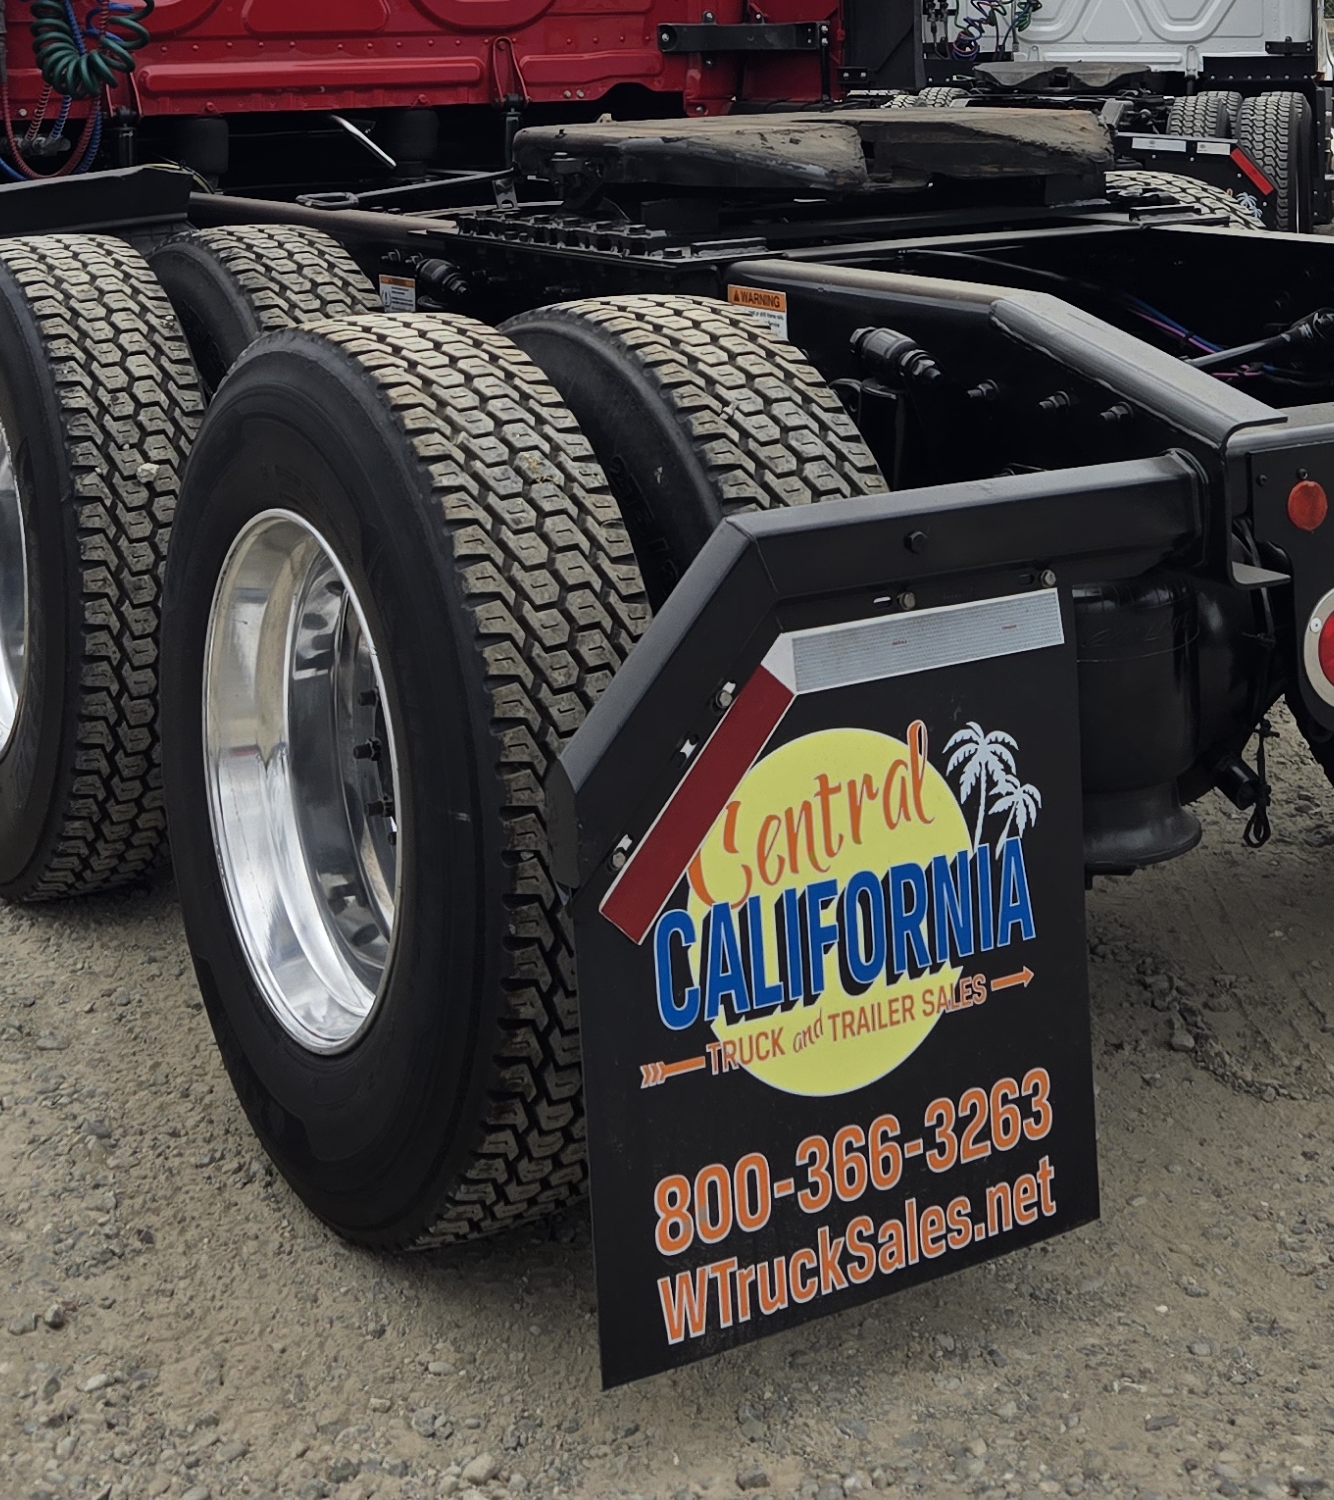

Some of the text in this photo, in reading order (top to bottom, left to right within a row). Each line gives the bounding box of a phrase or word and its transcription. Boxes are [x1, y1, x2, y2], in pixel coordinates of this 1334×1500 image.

[740, 290, 780, 308] WARNING
[686, 719, 936, 909] Central
[654, 836, 1037, 1031] CALIFORNIA
[705, 974, 987, 1075] TRUCK and TRAILER SALES
[653, 1067, 1054, 1256] 800-366-3263
[657, 1155, 1057, 1345] WTruckSales.net
